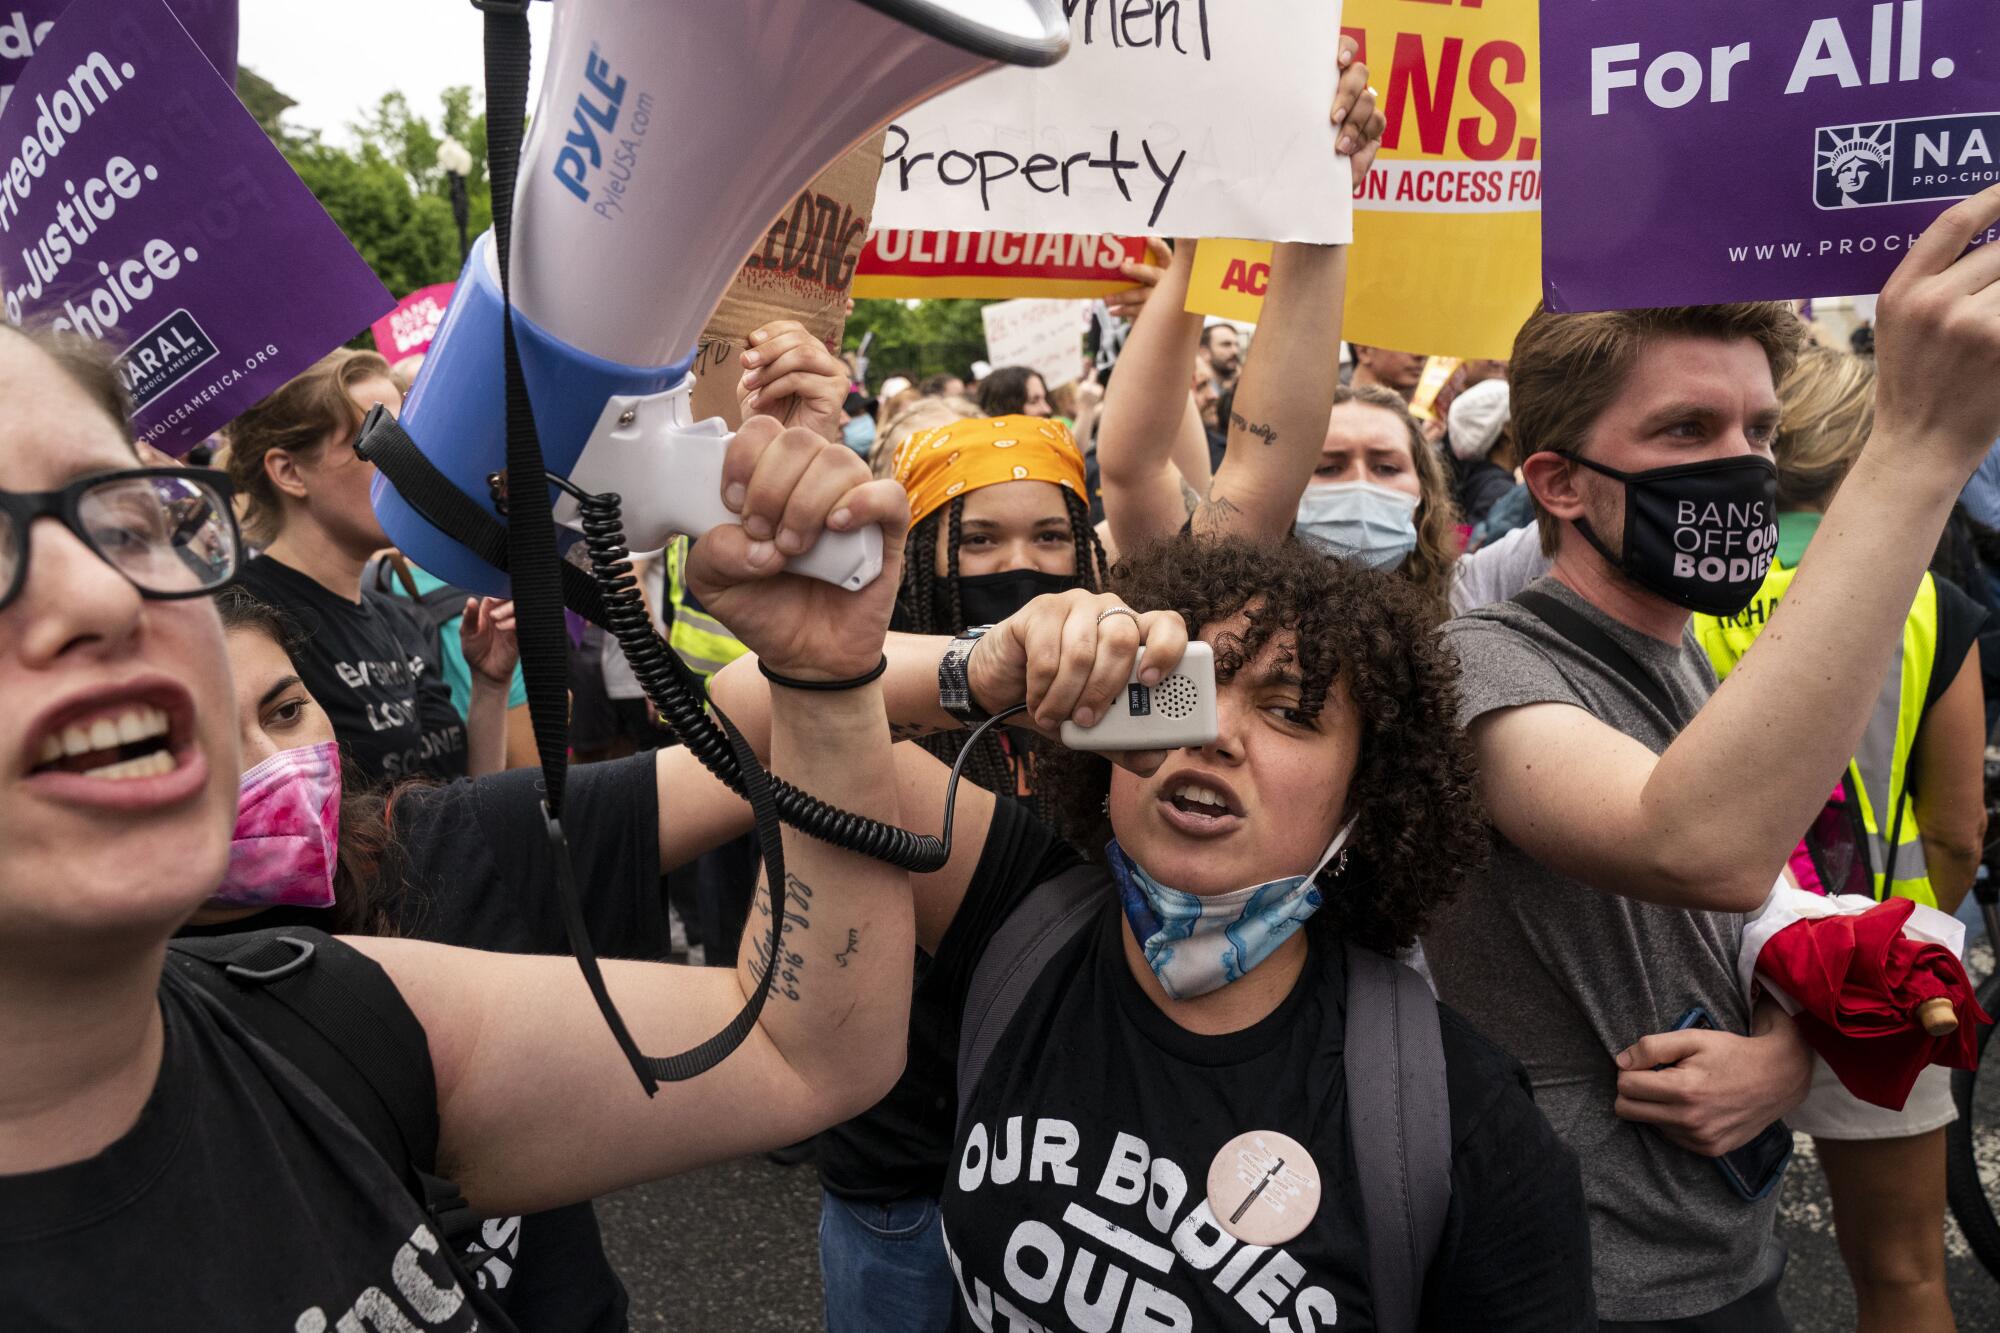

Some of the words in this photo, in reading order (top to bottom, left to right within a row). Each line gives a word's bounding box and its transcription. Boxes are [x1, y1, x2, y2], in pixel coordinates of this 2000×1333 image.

[1591, 41, 1750, 116] For
[1784, 0, 1955, 95] All.
[553, 49, 628, 203] PYLE
[1340, 26, 1538, 161] NS.
[594, 92, 654, 220] PyleUSA.com
[884, 124, 1187, 227] Property
[1396, 170, 1503, 203] ACCESS
[744, 189, 866, 290] EDING
[866, 229, 1135, 269] OLITICIANS.
[168, 346, 204, 374] AMERICA
[1673, 526, 1743, 556] OFF
[1678, 500, 1764, 528] BANS
[1673, 548, 1774, 583] BODIES
[1131, 690, 1140, 709] MIKE
[958, 1115, 1081, 1192] OUR
[1096, 1131, 1337, 1333] BODIES
